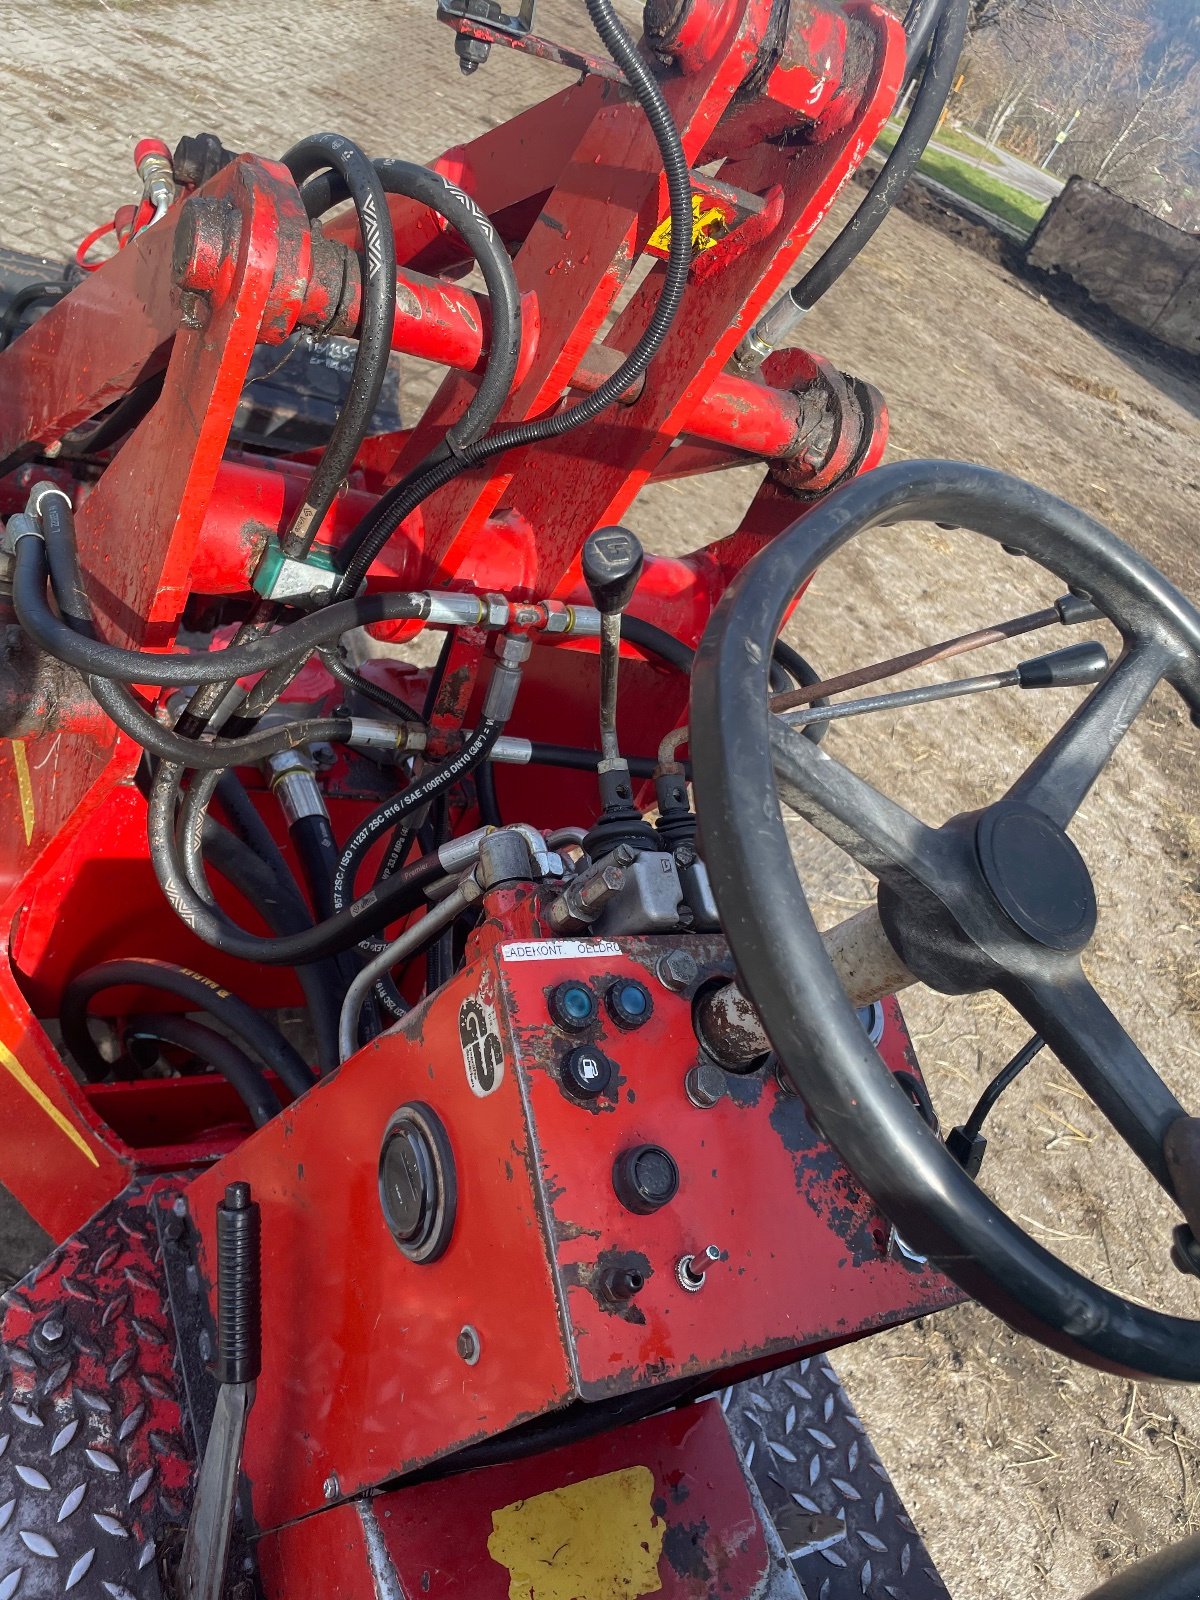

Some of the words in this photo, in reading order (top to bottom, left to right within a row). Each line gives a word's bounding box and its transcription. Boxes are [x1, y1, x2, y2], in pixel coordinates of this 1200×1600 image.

[449, 753, 471, 774] DN10
[422, 770, 451, 793] 100R16
[404, 789, 422, 805] SAE
[383, 803, 400, 819] R16
[368, 815, 385, 831] 2SC
[350, 828, 369, 850] 11237
[340, 850, 353, 867] ISO
[335, 872, 344, 891] 2SC
[334, 893, 342, 909] 857
